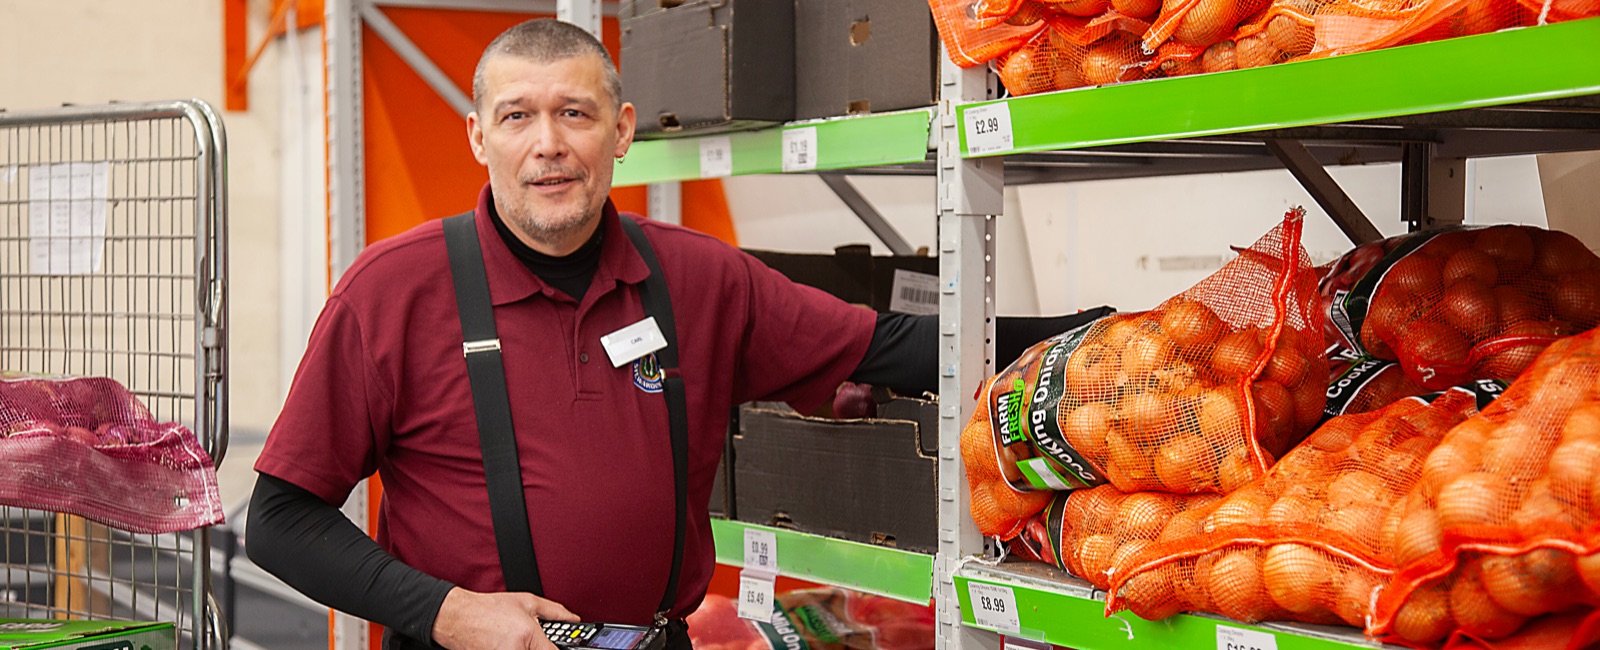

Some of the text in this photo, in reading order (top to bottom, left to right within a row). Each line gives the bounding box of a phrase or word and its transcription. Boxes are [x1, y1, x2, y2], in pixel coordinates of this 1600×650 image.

[975, 117, 999, 135] £2.99
[998, 394, 1012, 445] FARM
[1008, 389, 1020, 441] FRESH
[1032, 409, 1096, 481] Cooking
[752, 541, 768, 555] £0.99
[747, 590, 764, 605] £5.49
[981, 596, 1005, 612] £8.99
[772, 611, 795, 635] Mild
